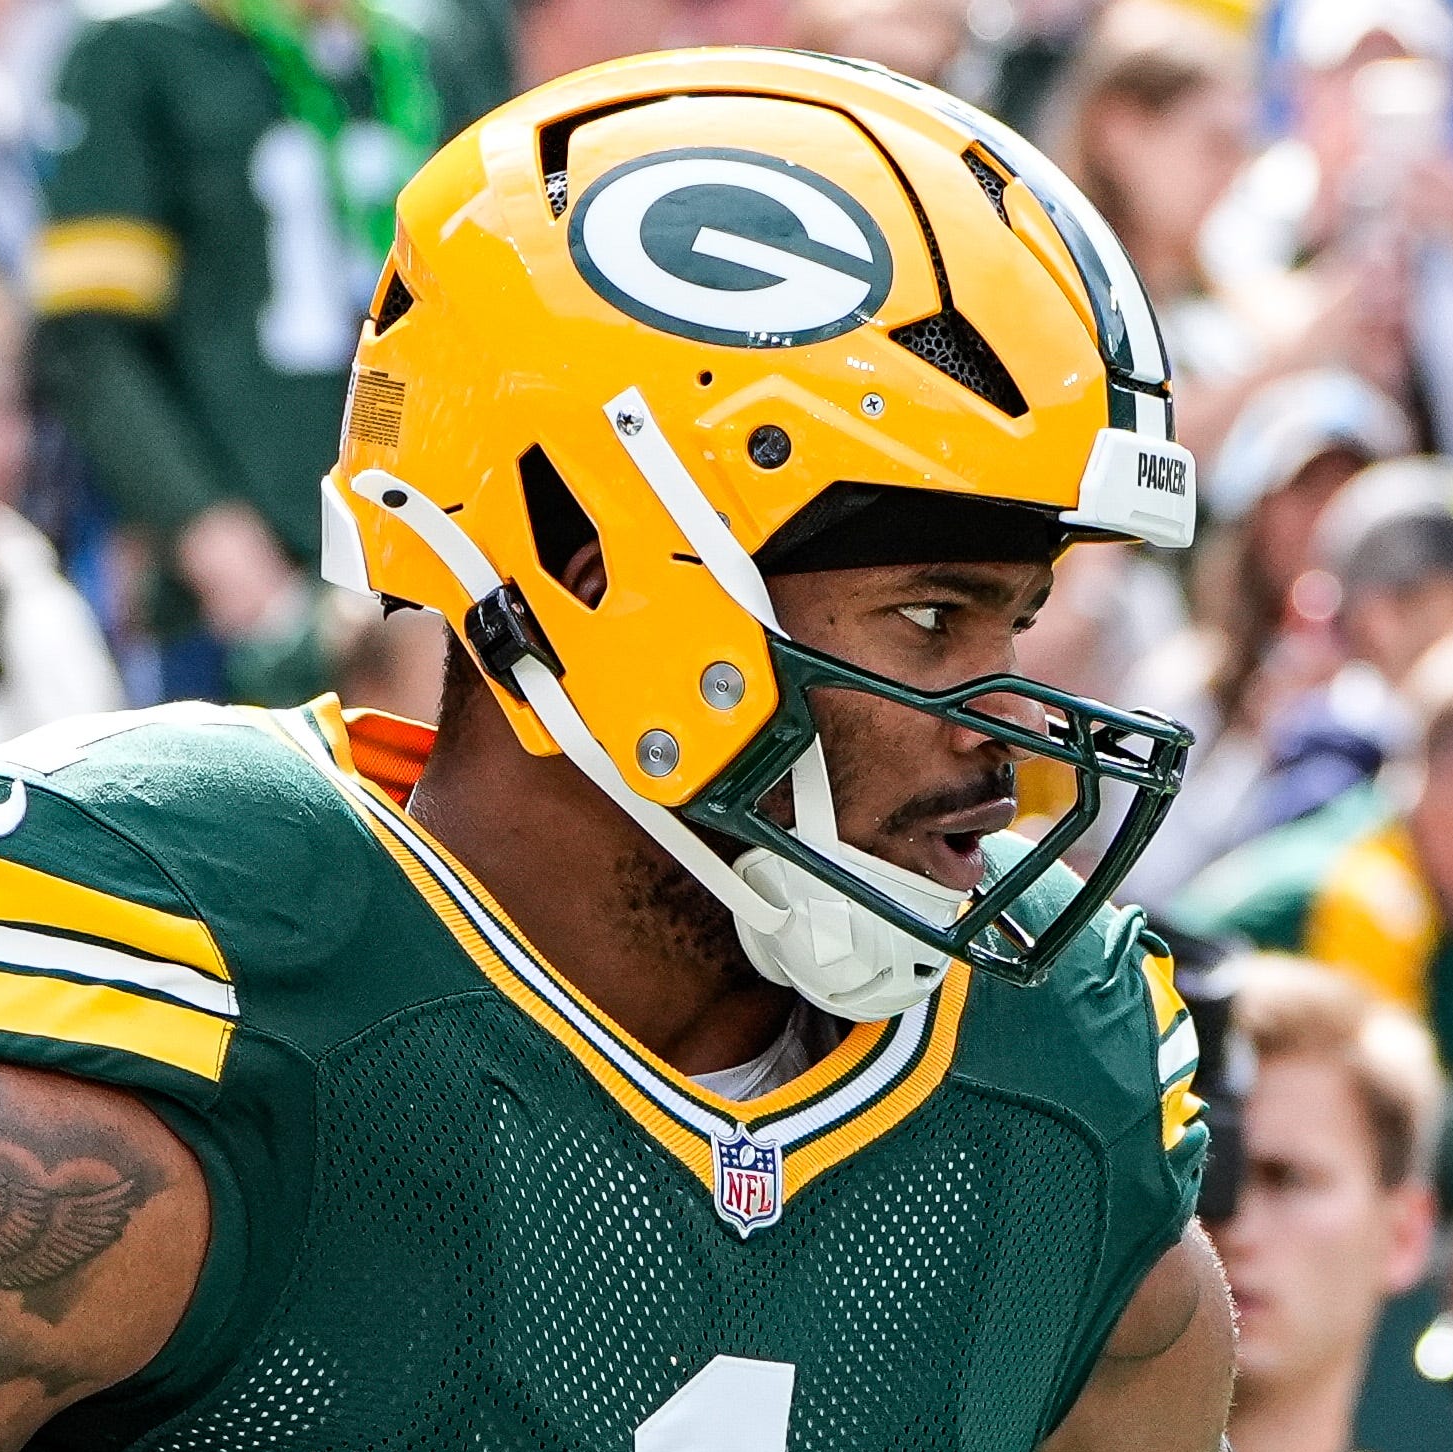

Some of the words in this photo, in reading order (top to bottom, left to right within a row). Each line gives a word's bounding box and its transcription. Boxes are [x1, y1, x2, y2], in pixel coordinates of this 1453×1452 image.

[582, 158, 875, 334] G
[1137, 452, 1187, 497] PACKERS
[726, 1171, 772, 1217] NFL
